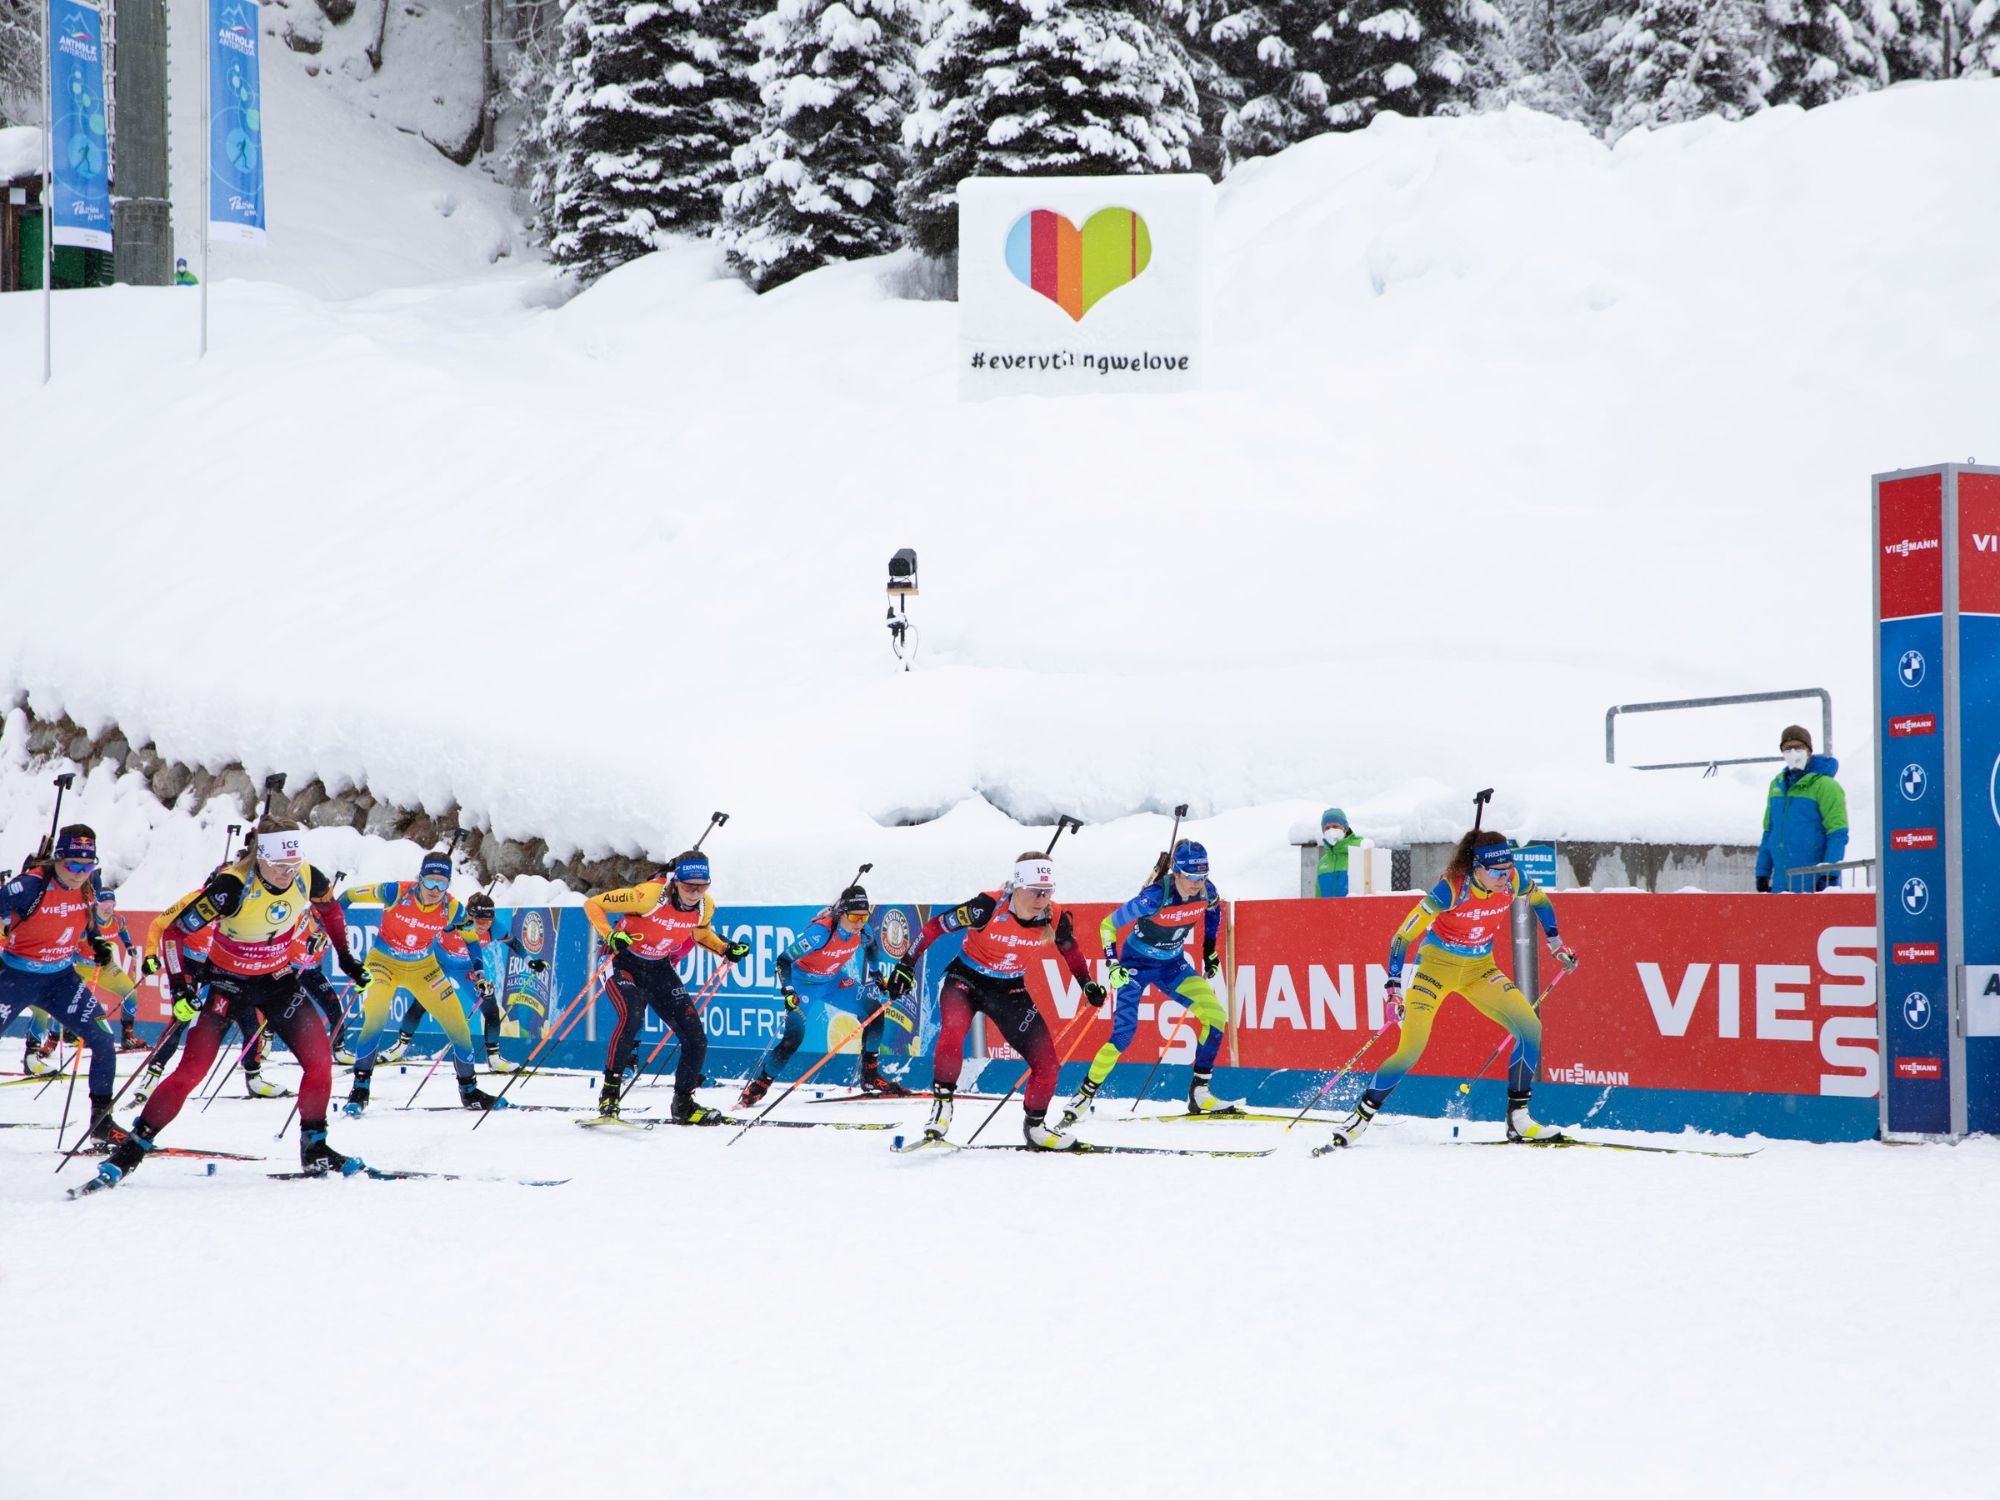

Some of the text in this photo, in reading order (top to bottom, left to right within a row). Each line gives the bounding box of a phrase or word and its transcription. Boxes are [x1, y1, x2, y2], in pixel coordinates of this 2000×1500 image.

[59, 35, 97, 54] ANTHOLZ
[219, 29, 255, 48] ANTHOLZ
[971, 350, 1189, 375] #everytngwelove
[1885, 539, 1938, 557] VIESSMANN
[1485, 848, 1512, 859] FRISTAD
[1513, 853, 1552, 862] UE BUBBLE
[602, 892, 629, 903] Audi
[990, 933, 1043, 948] VIESSMAN
[81, 995, 99, 1023] FALCO
